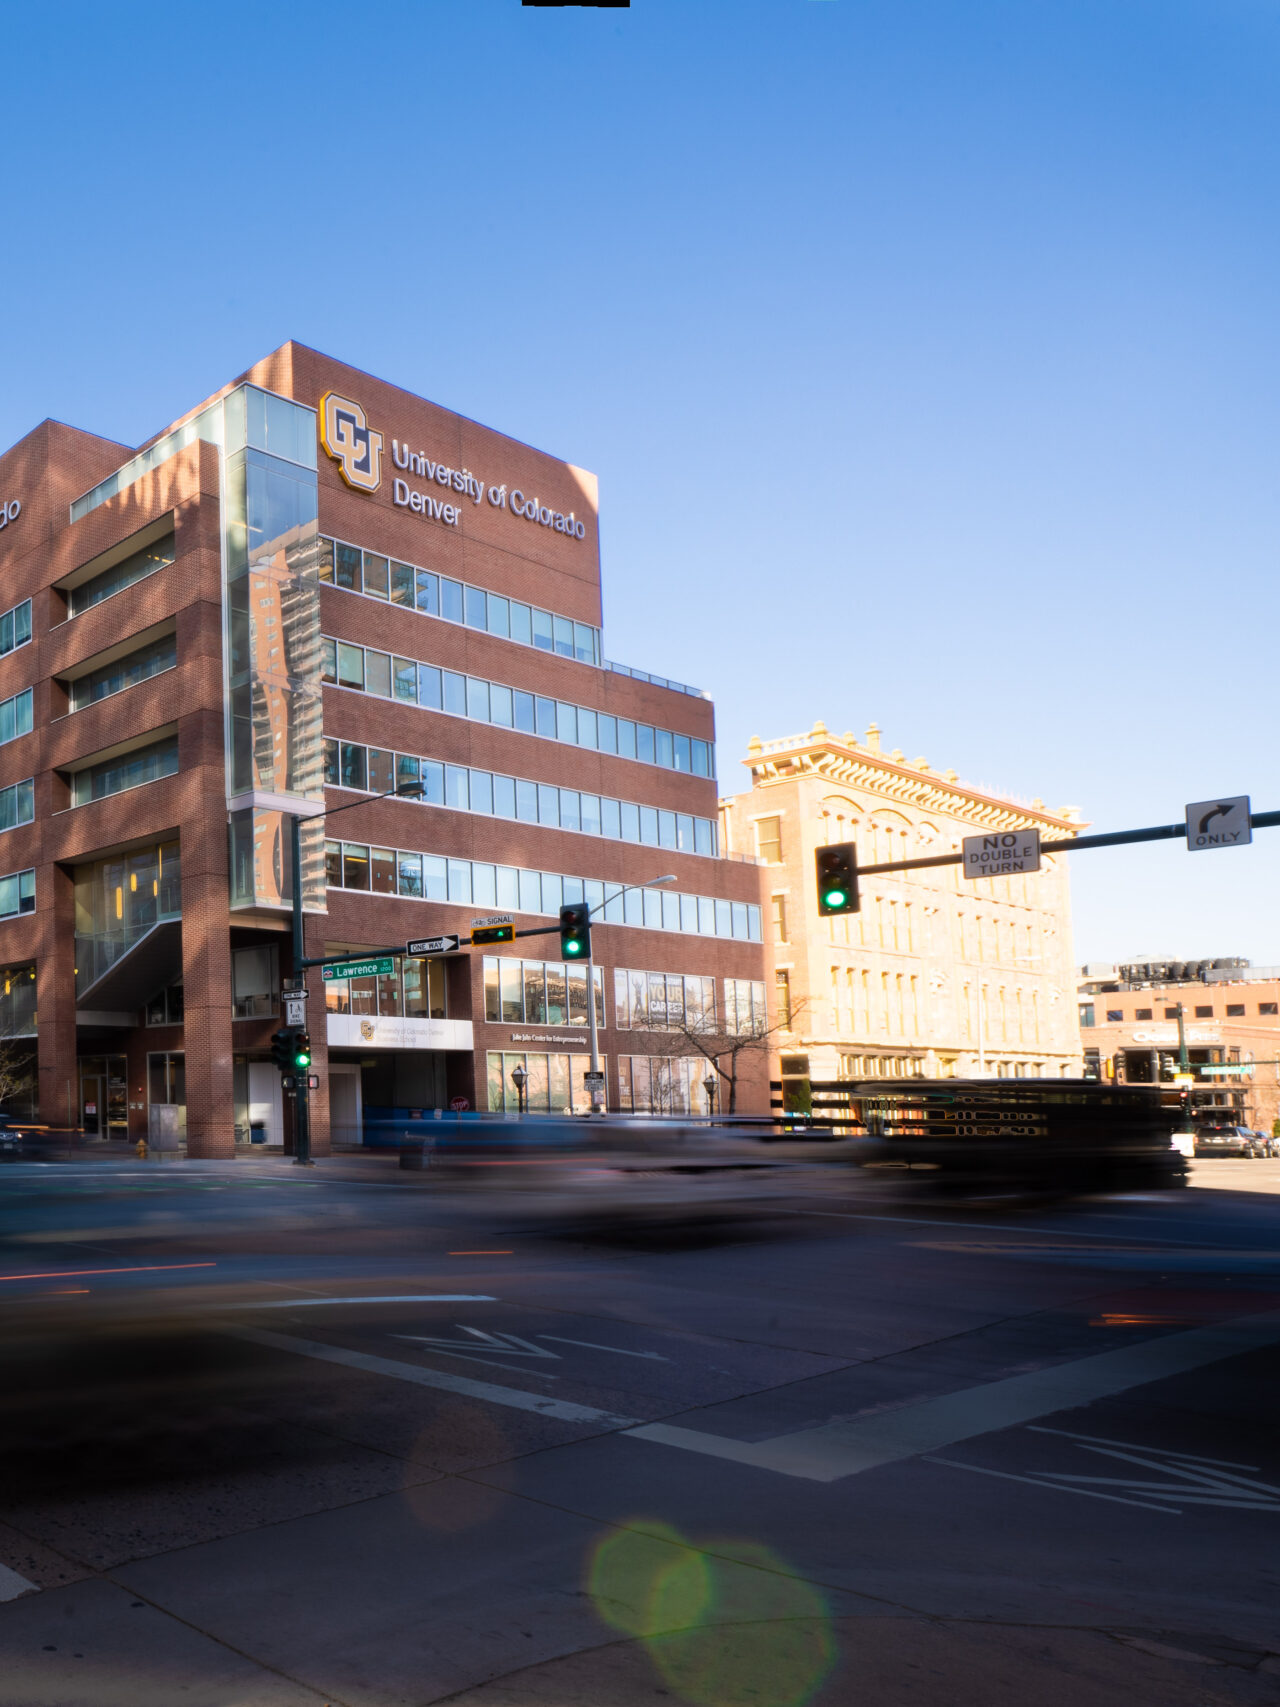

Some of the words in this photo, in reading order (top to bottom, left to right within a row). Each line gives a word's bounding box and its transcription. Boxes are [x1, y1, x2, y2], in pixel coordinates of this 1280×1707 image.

[392, 440, 484, 504] University
[487, 484, 507, 509] of
[509, 490, 586, 541] Colorado
[393, 478, 462, 527] Denver
[983, 834, 1017, 850] NO
[1195, 831, 1241, 847] ONLY
[970, 846, 1032, 864] DOUBLE
[979, 861, 1024, 875] TURN
[487, 916, 512, 925] SIGNAL
[337, 965, 378, 977] Lawrence
[650, 984, 683, 1001] YOUR
[650, 1000, 683, 1013] CAREER
[451, 1100, 469, 1111] STOP
